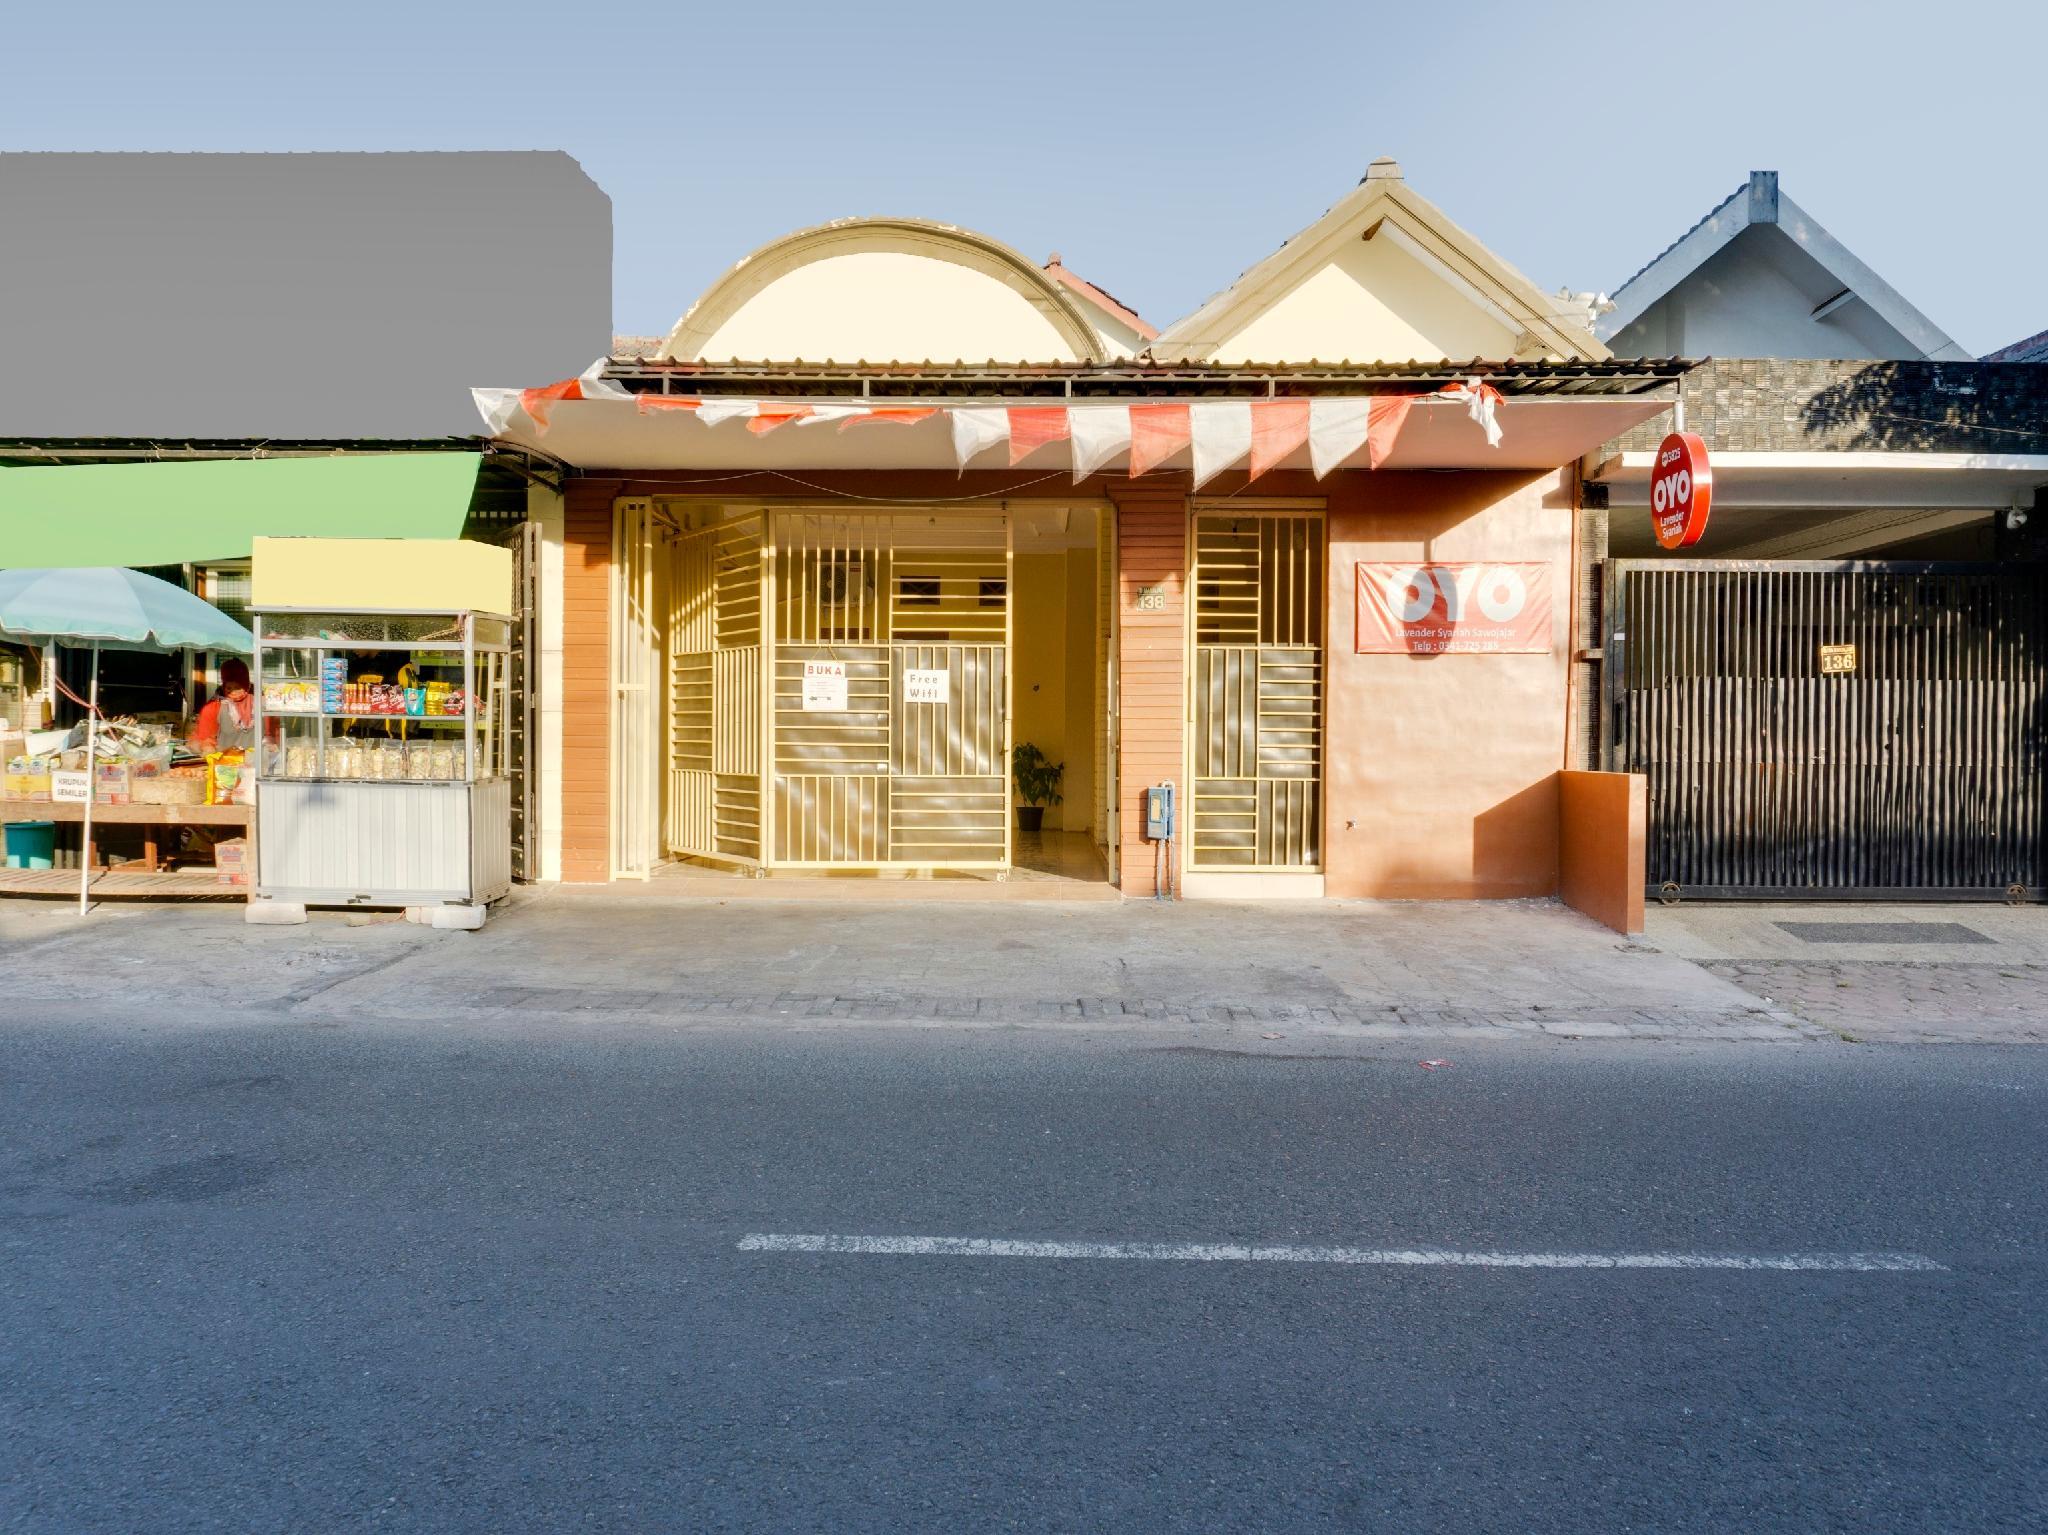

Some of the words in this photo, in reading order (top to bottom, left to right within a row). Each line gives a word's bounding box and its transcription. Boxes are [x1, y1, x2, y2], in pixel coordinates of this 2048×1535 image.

[1654, 469, 1691, 513] OYO
[1660, 510, 1685, 527] Lavender
[1386, 566, 1527, 623] OYO
[1139, 595, 1164, 609] 138
[1395, 627, 1436, 638] Lavender
[1437, 627, 1471, 639] Syariah
[1413, 641, 1432, 652] Telp
[1824, 654, 1853, 670] 136
[808, 665, 842, 676] BUKA
[910, 674, 938, 683] Free
[58, 778, 88, 787] KRUPUK
